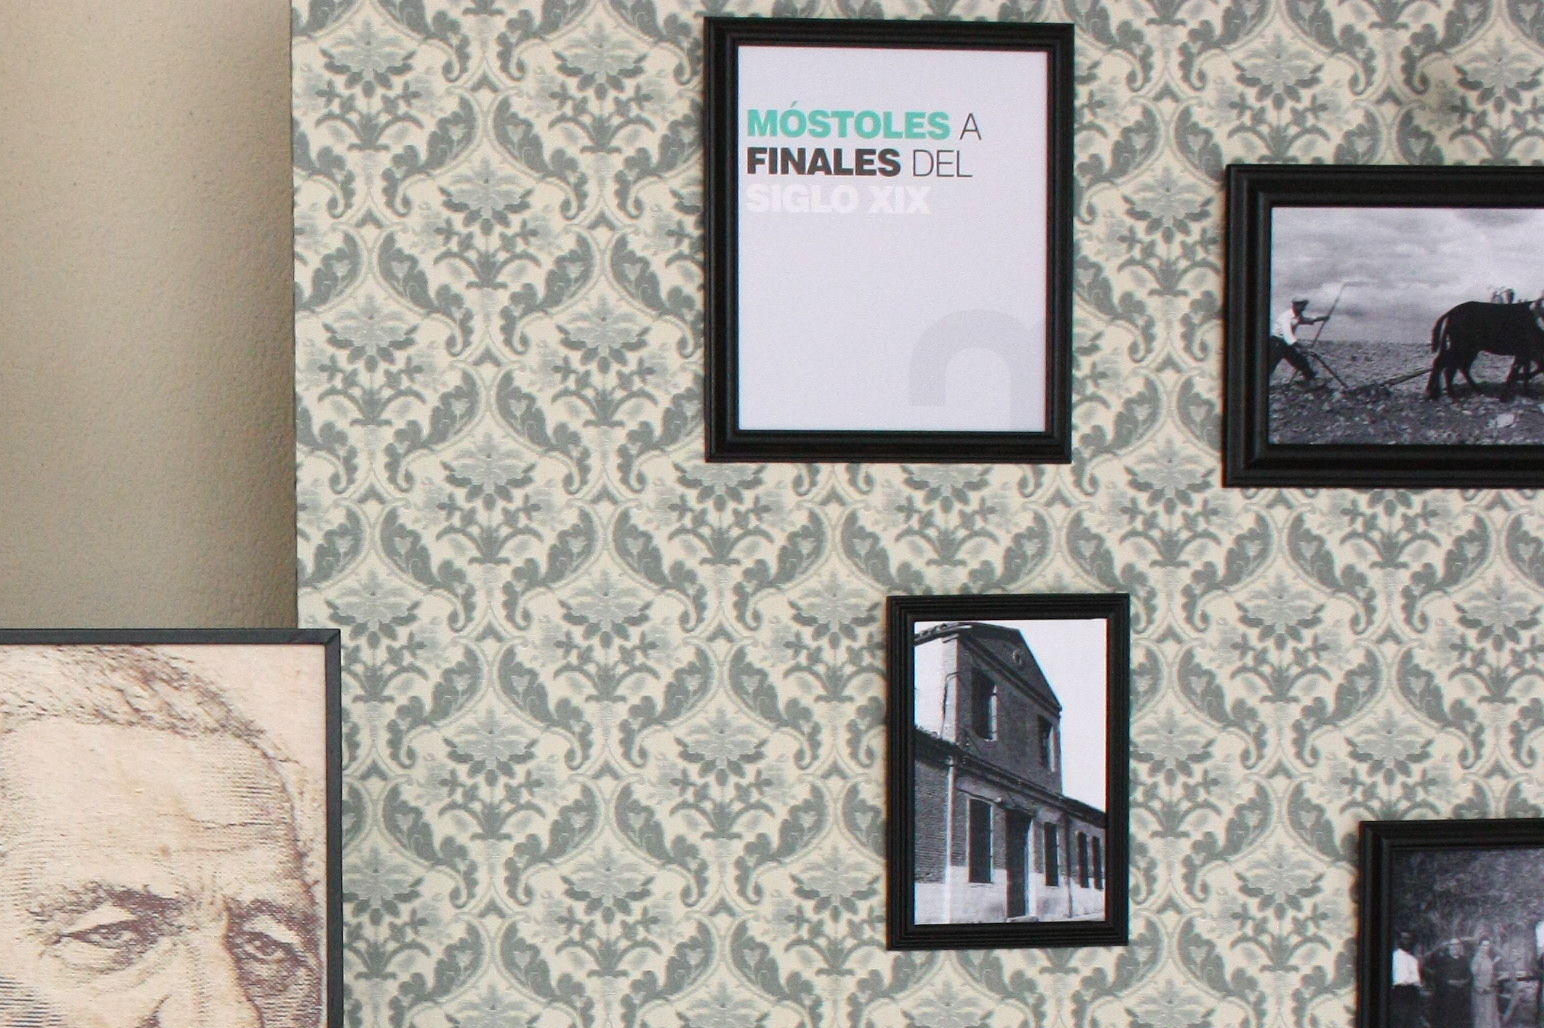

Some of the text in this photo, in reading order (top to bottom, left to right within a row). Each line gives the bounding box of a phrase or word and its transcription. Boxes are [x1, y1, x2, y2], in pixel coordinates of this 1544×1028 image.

[747, 101, 981, 140] MÓSTOLES A
[747, 147, 972, 177] FINALES DEL
[746, 183, 932, 214] SIGLO XIX
